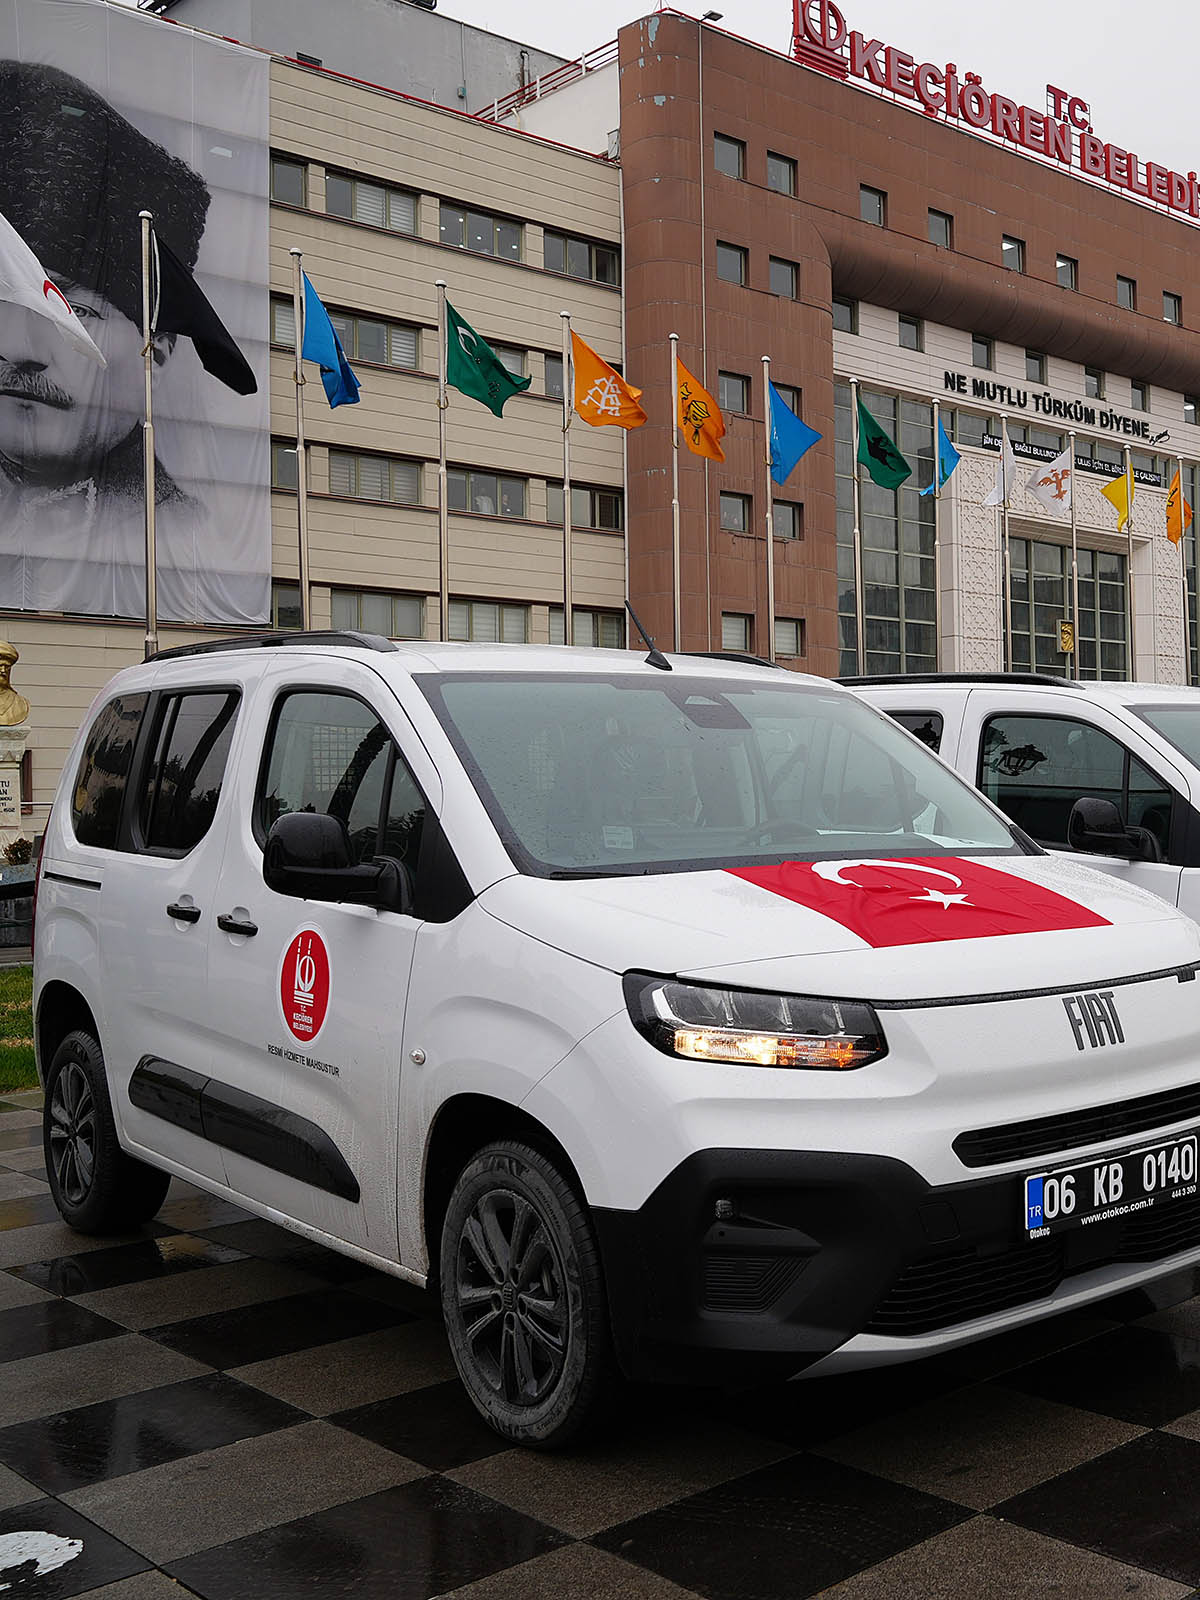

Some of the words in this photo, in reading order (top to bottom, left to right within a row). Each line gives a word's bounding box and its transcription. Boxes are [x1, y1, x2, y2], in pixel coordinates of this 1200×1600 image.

[849, 30, 1072, 165] KEÇİÖREN
[1047, 84, 1093, 134] T.C.
[944, 371, 967, 393] NE
[972, 378, 1027, 408] MUTLU
[1032, 392, 1096, 425] TÜRKÜM
[1100, 408, 1150, 438] DİYENE
[1061, 991, 1125, 1051] FIAT
[1028, 1205, 1042, 1218] TR
[1043, 1174, 1076, 1219] 06
[1093, 1162, 1123, 1207] KB
[1143, 1144, 1194, 1192] 0140
[1080, 1197, 1155, 1226] www.otokoc.com.tr
